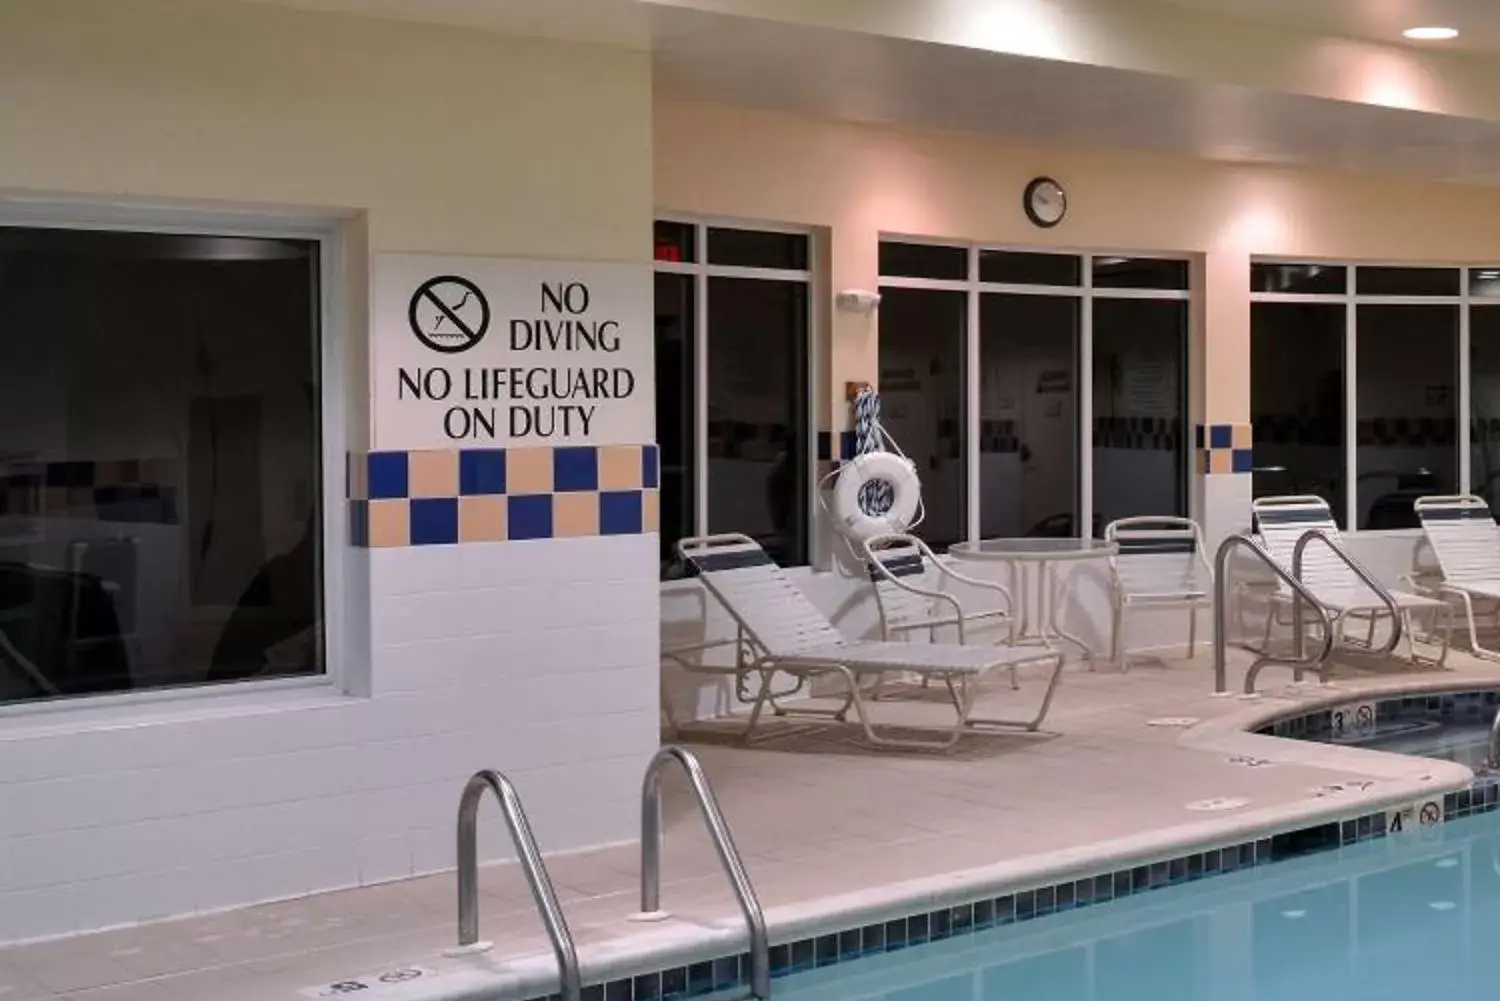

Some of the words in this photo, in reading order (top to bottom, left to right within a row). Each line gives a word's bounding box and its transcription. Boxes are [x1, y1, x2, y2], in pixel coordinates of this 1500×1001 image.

[541, 281, 590, 314] NO
[509, 319, 621, 352] DIVING
[398, 367, 450, 400] NO
[464, 367, 635, 399] LIFEGUARD
[443, 406, 495, 439] ON
[509, 405, 596, 437] DUTY
